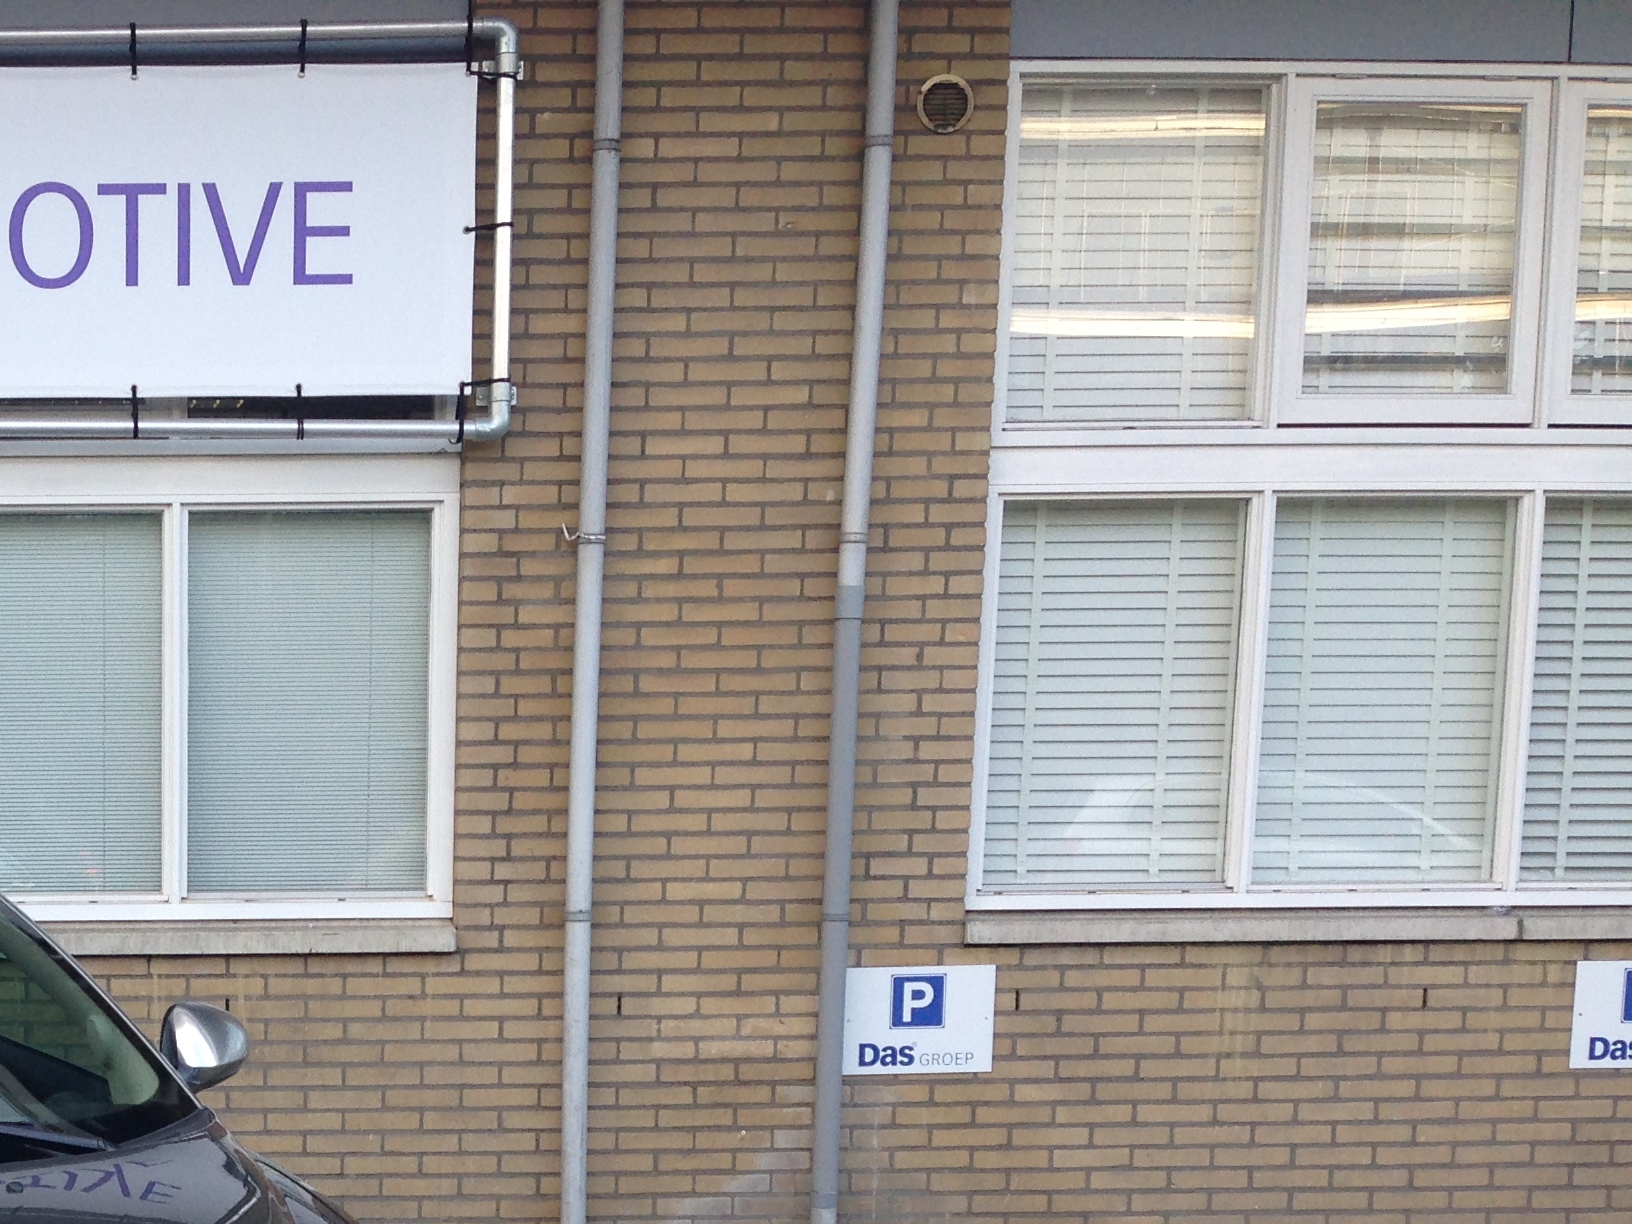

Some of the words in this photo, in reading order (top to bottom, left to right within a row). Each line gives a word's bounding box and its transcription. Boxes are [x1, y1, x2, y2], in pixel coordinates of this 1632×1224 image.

[902, 981, 935, 1023] P
[858, 1043, 915, 1067] Das
[919, 1052, 974, 1067] GROEP
[1588, 1036, 1632, 1061] Da
